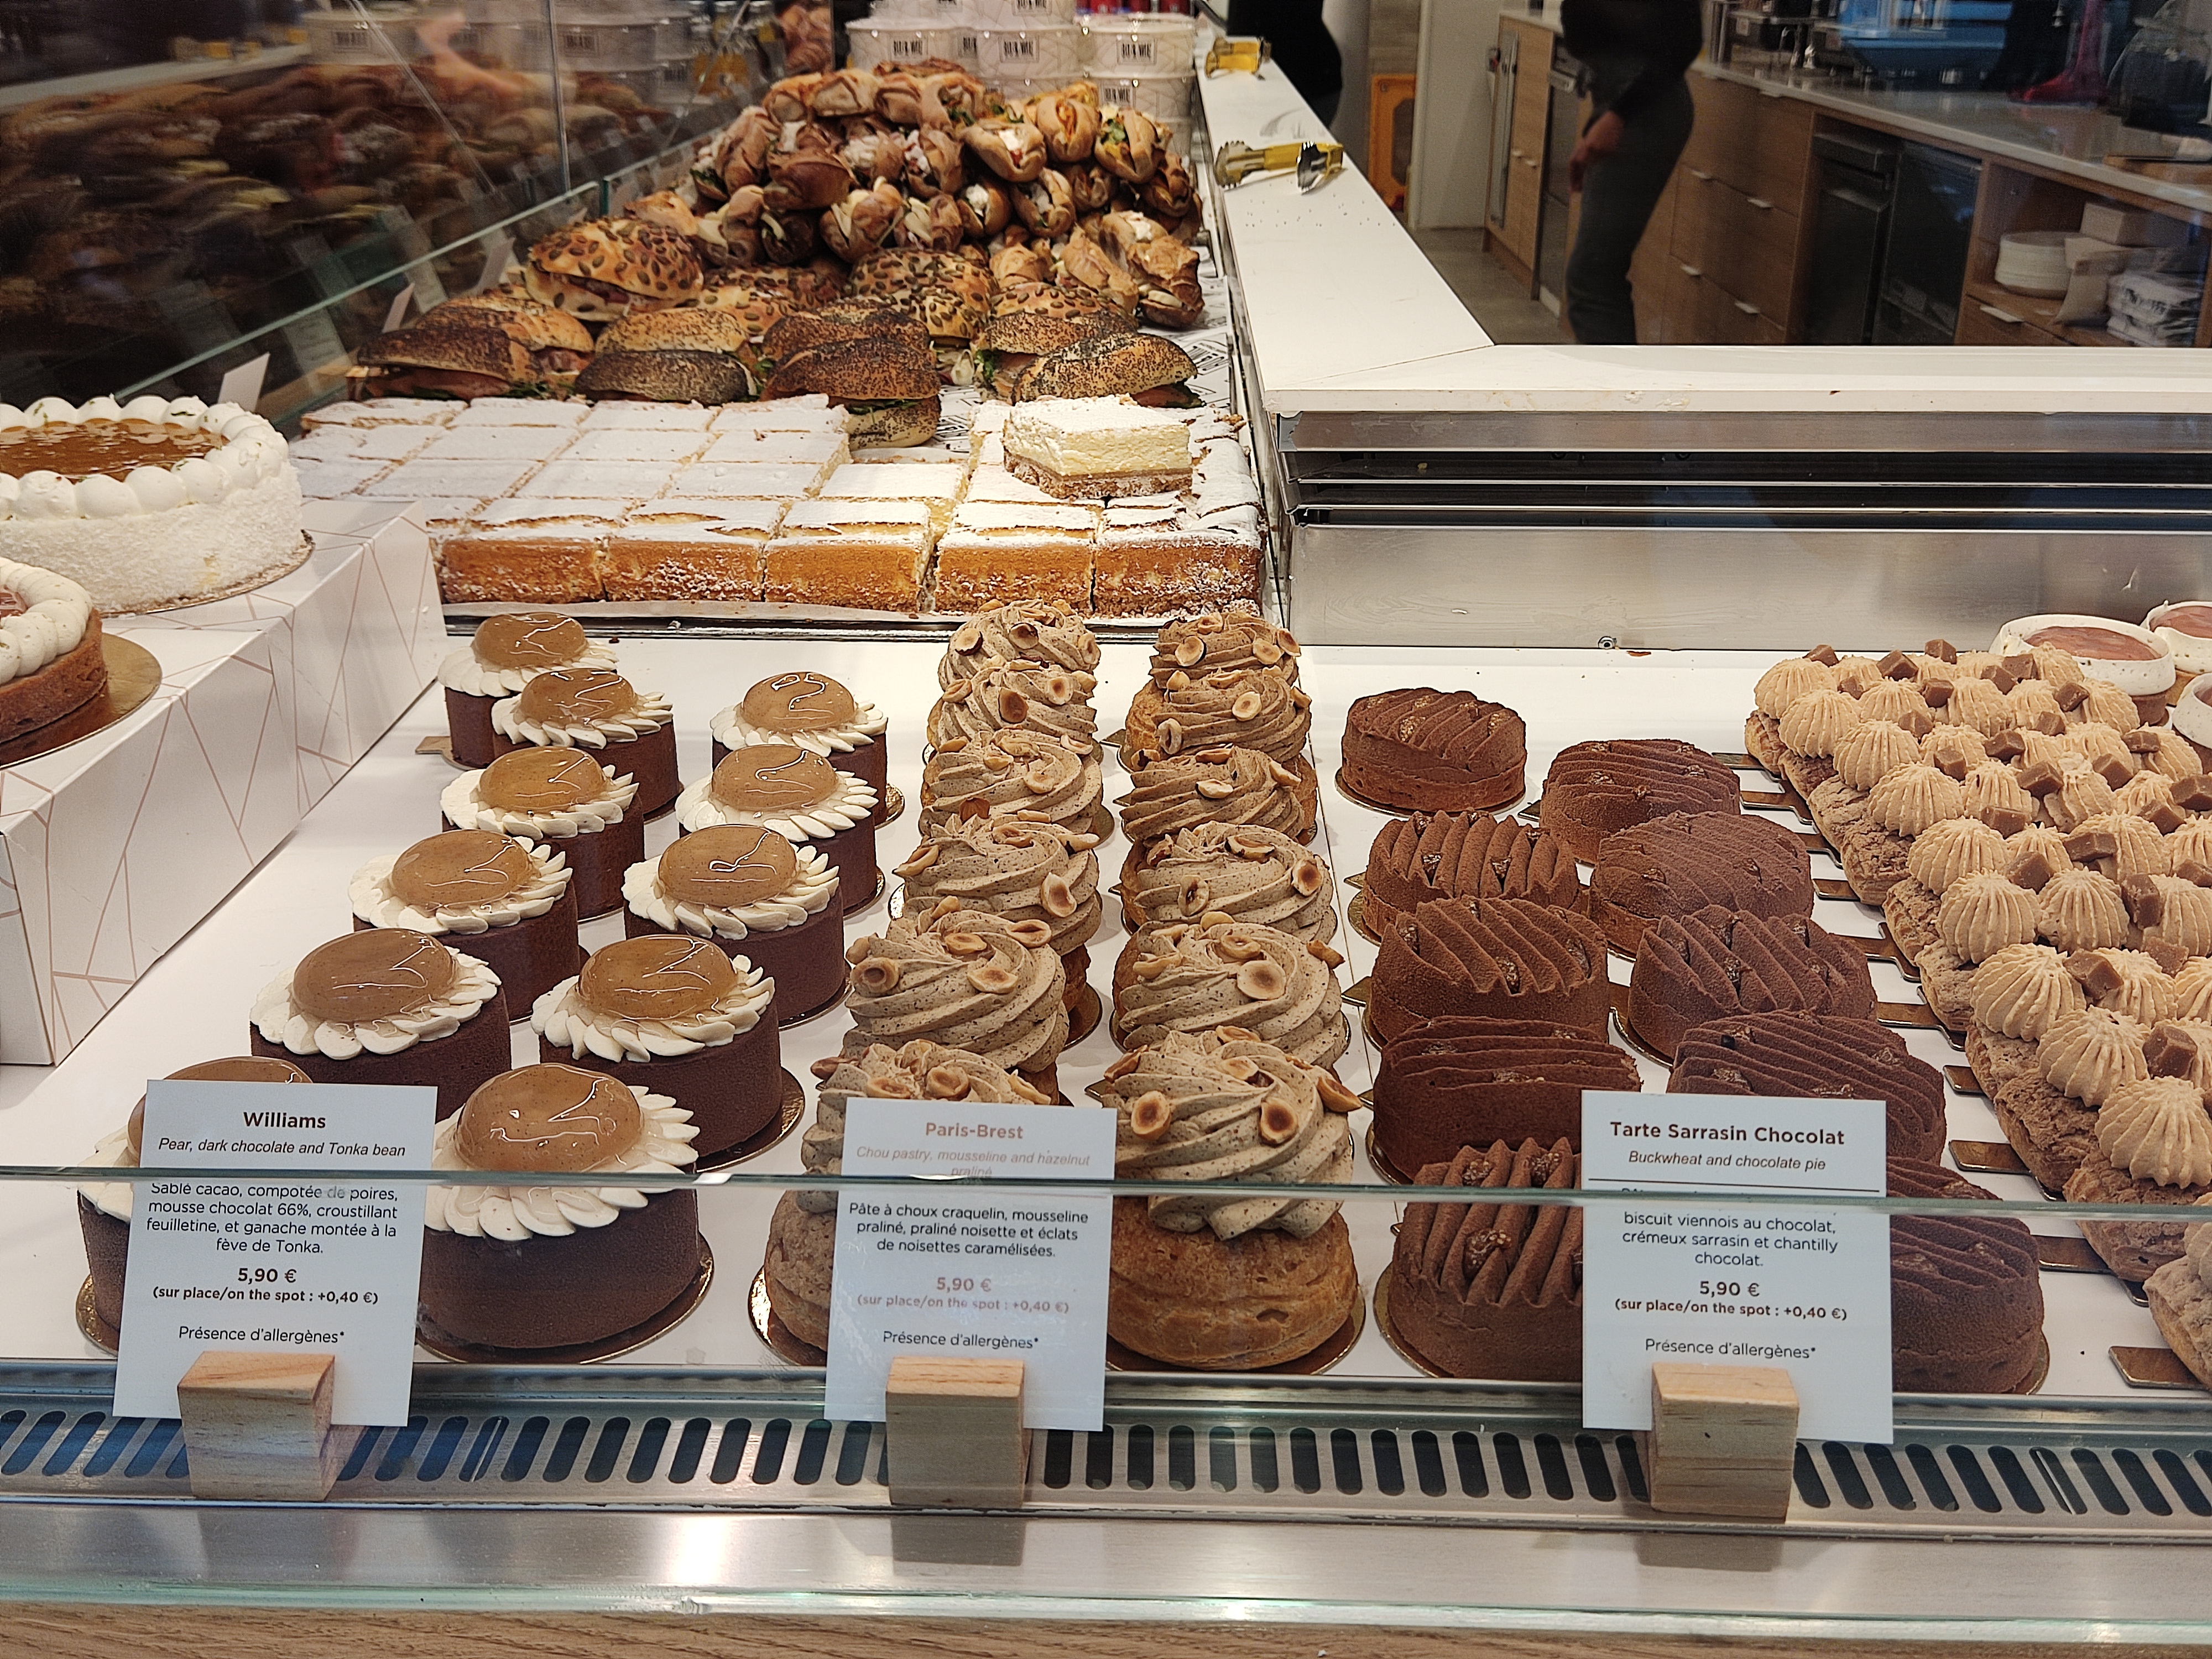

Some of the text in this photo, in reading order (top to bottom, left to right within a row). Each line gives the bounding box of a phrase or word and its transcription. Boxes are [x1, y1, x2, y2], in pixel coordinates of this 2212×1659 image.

[243, 1112, 325, 1128] Williams
[925, 1122, 1023, 1139] Paris-Brest
[1610, 1121, 1844, 1144] Tarte Sarrasin Chocolat
[158, 1138, 405, 1156] Pear, dark chocolate and Tonka bean
[857, 1146, 889, 1158] Chou
[937, 1150, 1007, 1162] mousseline
[1010, 1152, 1034, 1163] and
[1037, 1152, 1090, 1166] hazelnut
[1629, 1150, 1825, 1172] Buckwheat and chocolate pie
[151, 1182, 397, 1201] Sablé cacao, compotée de poires,
[148, 1201, 397, 1218] mousse chocolat 66%, croustillant
[849, 1202, 1088, 1223] Pâte à choux craquelin, mousseline
[147, 1217, 396, 1237] feuilletine, et ganache montée à la
[857, 1220, 1077, 1240] praliné, praliné noisette et éclats
[1624, 1211, 1835, 1234] biscuit viennois au chocolat,
[216, 1237, 322, 1253] fève de Tonka.
[877, 1238, 1055, 1256] de noisettes caramélisées.
[1622, 1230, 1838, 1253] crémeux sarrasin et chantilly
[1695, 1251, 1763, 1266] chocolat.
[237, 1267, 296, 1285] 5,90 €
[936, 1276, 991, 1293] 5,90 €
[153, 1286, 179, 1298] (sur
[183, 1286, 244, 1300] place/on
[249, 1288, 270, 1300] the
[275, 1291, 305, 1302] spot
[317, 1291, 358, 1304] +0,40
[363, 1291, 378, 1305] €)
[1700, 1280, 1759, 1297] 5,90 €
[857, 1294, 882, 1306] (sur
[886, 1295, 943, 1308] place/on
[947, 1297, 967, 1307] the
[972, 1300, 999, 1310] spot
[1013, 1300, 1050, 1312] +0,40
[1055, 1301, 1069, 1314] €)
[1615, 1298, 1641, 1310] (sur
[1646, 1299, 1708, 1313] place/on
[1713, 1302, 1735, 1313] the
[1740, 1305, 1770, 1317] spot
[1783, 1306, 1825, 1319] +0,40
[1831, 1307, 1846, 1321] €)
[179, 1326, 246, 1340] Présence
[883, 1331, 946, 1345] Présence
[1645, 1338, 1713, 1354] Présence
